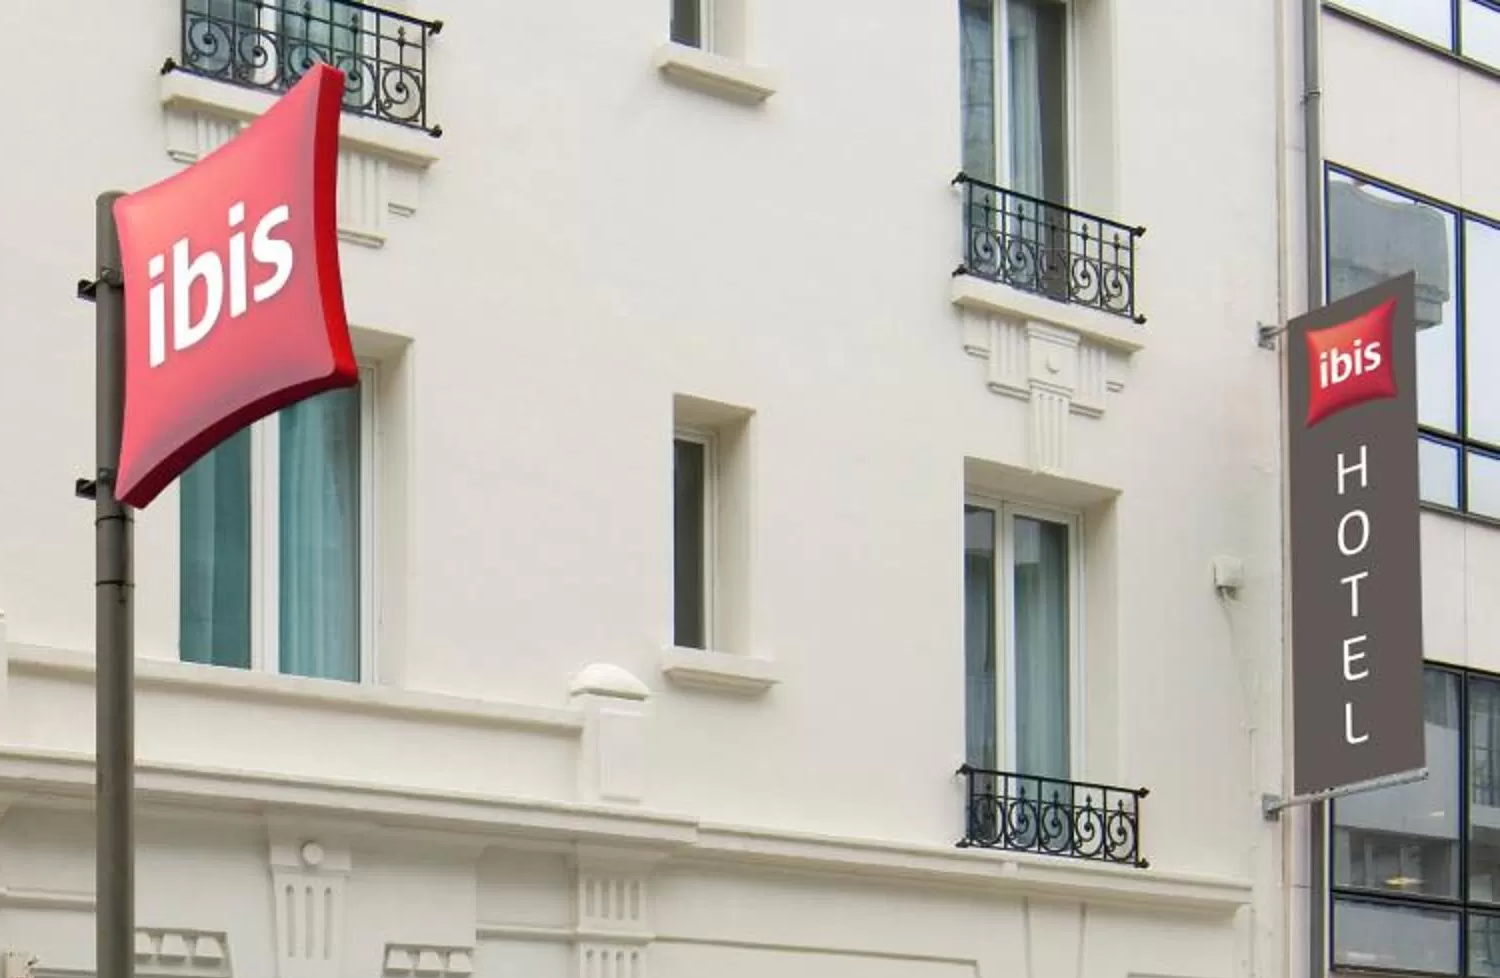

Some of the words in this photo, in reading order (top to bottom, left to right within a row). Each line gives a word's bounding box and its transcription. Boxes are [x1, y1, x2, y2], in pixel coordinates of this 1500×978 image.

[147, 201, 294, 368] ibis
[1318, 338, 1382, 389] ibis
[1336, 443, 1370, 746] HOTEL
